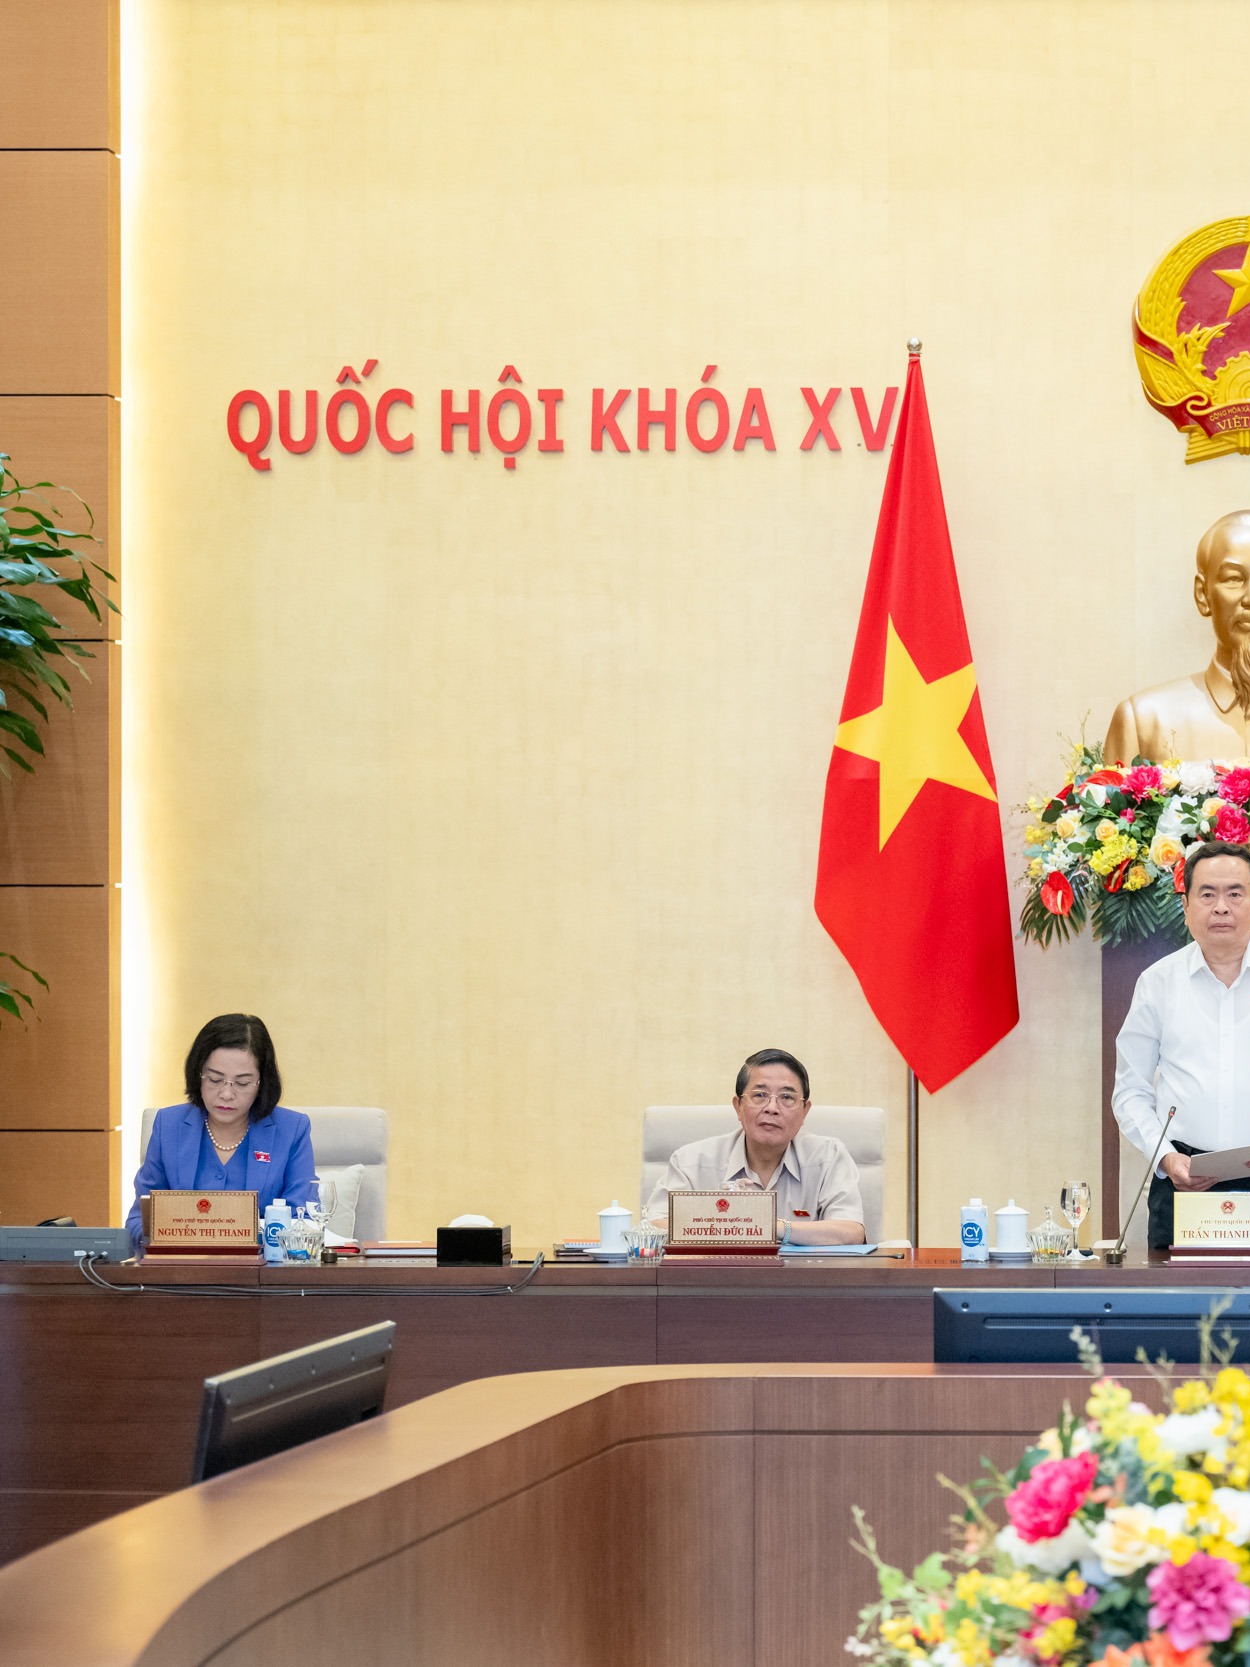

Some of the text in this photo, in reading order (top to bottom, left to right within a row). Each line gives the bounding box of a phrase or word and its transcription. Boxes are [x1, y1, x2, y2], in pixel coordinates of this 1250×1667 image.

[227, 359, 899, 471] QUỐC HỘI KHÓA XV
[1216, 414, 1250, 431] VIỆT
[158, 1224, 251, 1238] NGUYỄN THỊ THANH
[682, 1224, 763, 1236] NGUYỄN ĐỨC HẢI
[963, 1226, 980, 1237] ICY
[1212, 1230, 1249, 1239] THANH
